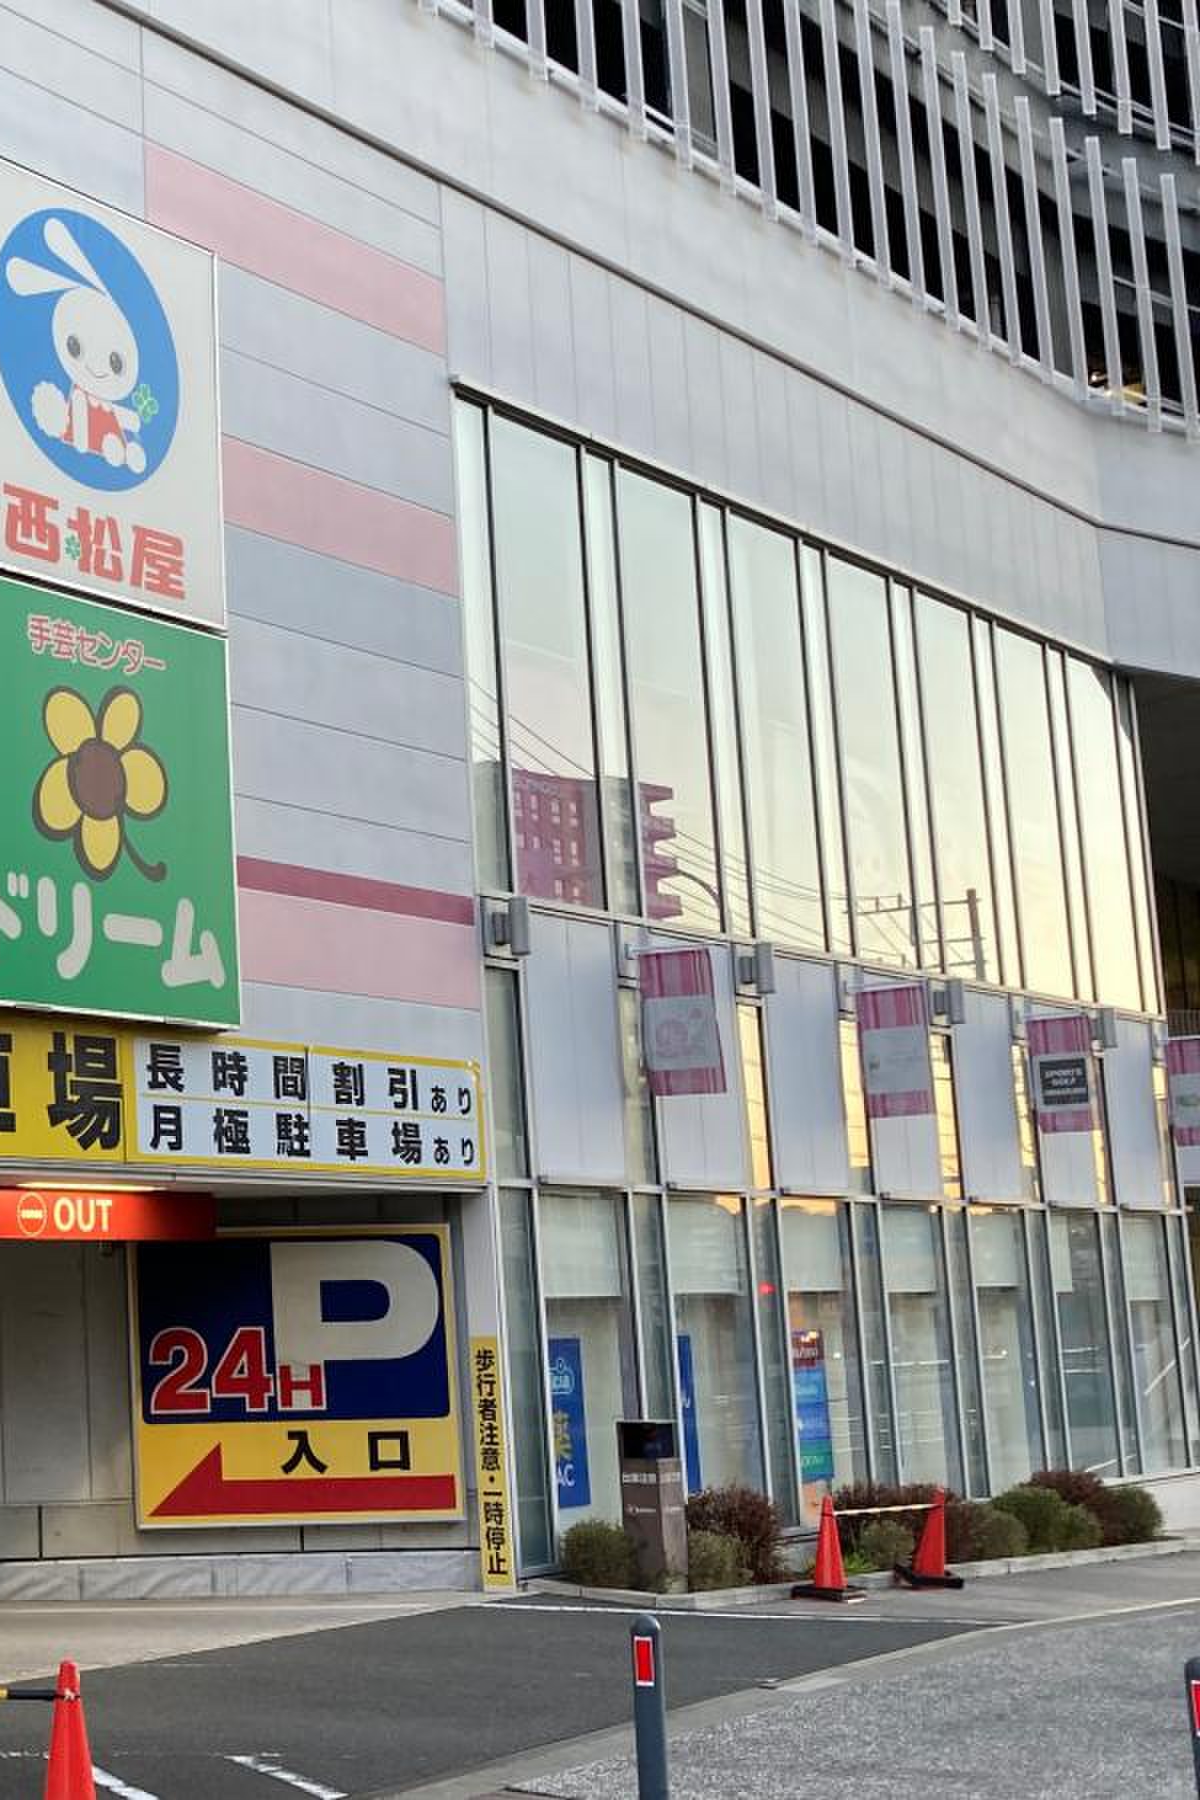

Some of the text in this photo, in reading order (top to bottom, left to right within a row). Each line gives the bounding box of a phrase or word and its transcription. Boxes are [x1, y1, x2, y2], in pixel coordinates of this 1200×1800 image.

[2, 482, 187, 600] 西松屋
[27, 613, 167, 675] 手芸センター
[146, 1043, 473, 1116] 長時間割引あり
[149, 1103, 475, 1166] 月極駐車場あり
[53, 1196, 113, 1233] OUT
[269, 1239, 440, 1410] P
[149, 1325, 328, 1415] 24H
[280, 1430, 411, 1475] 入口
